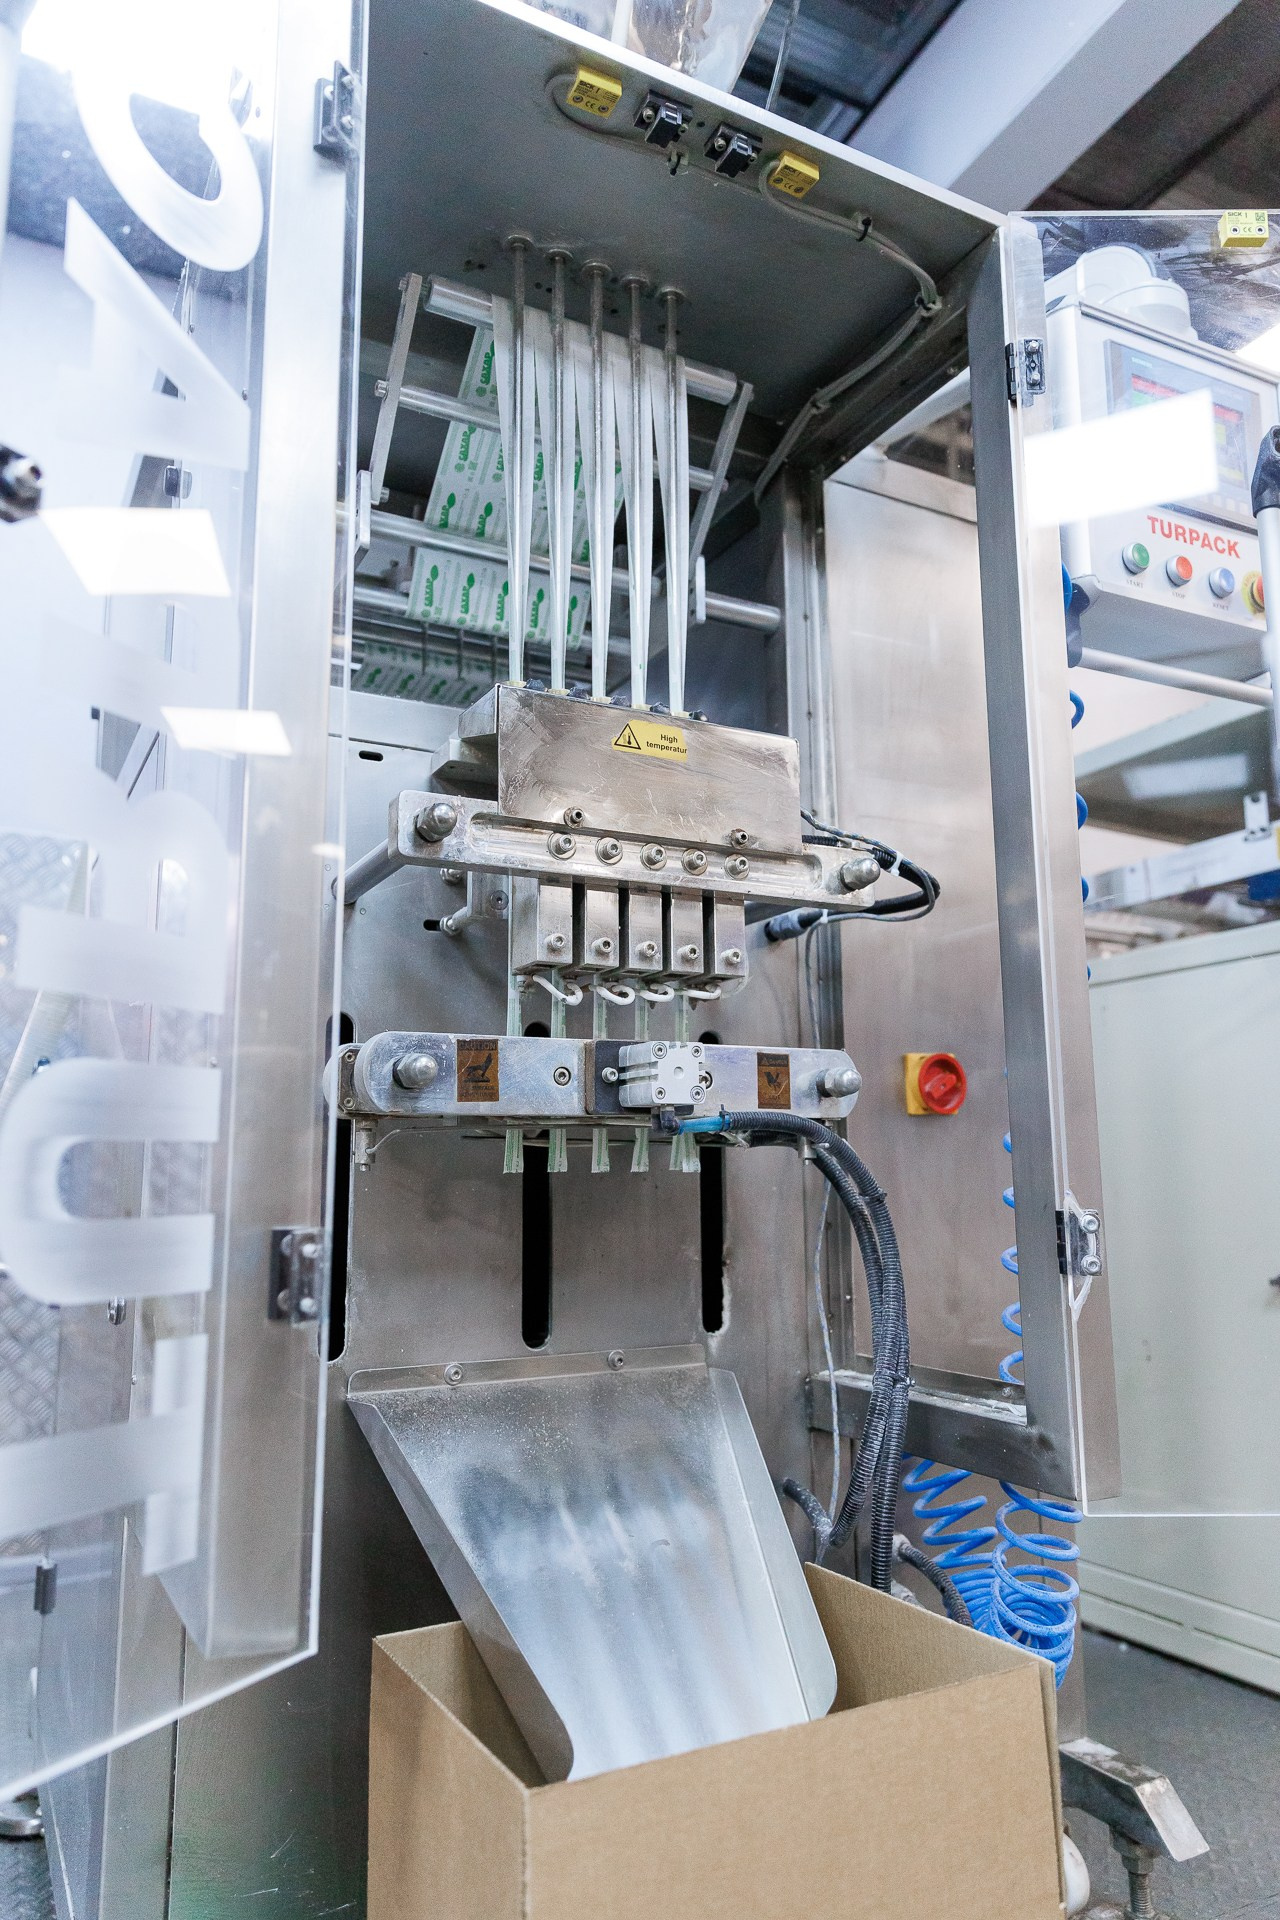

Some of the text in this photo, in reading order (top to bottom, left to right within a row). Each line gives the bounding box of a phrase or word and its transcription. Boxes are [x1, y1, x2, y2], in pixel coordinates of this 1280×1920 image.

[1147, 514, 1241, 559] TURPACK
[1126, 579, 1144, 589] START
[660, 734, 678, 744] High
